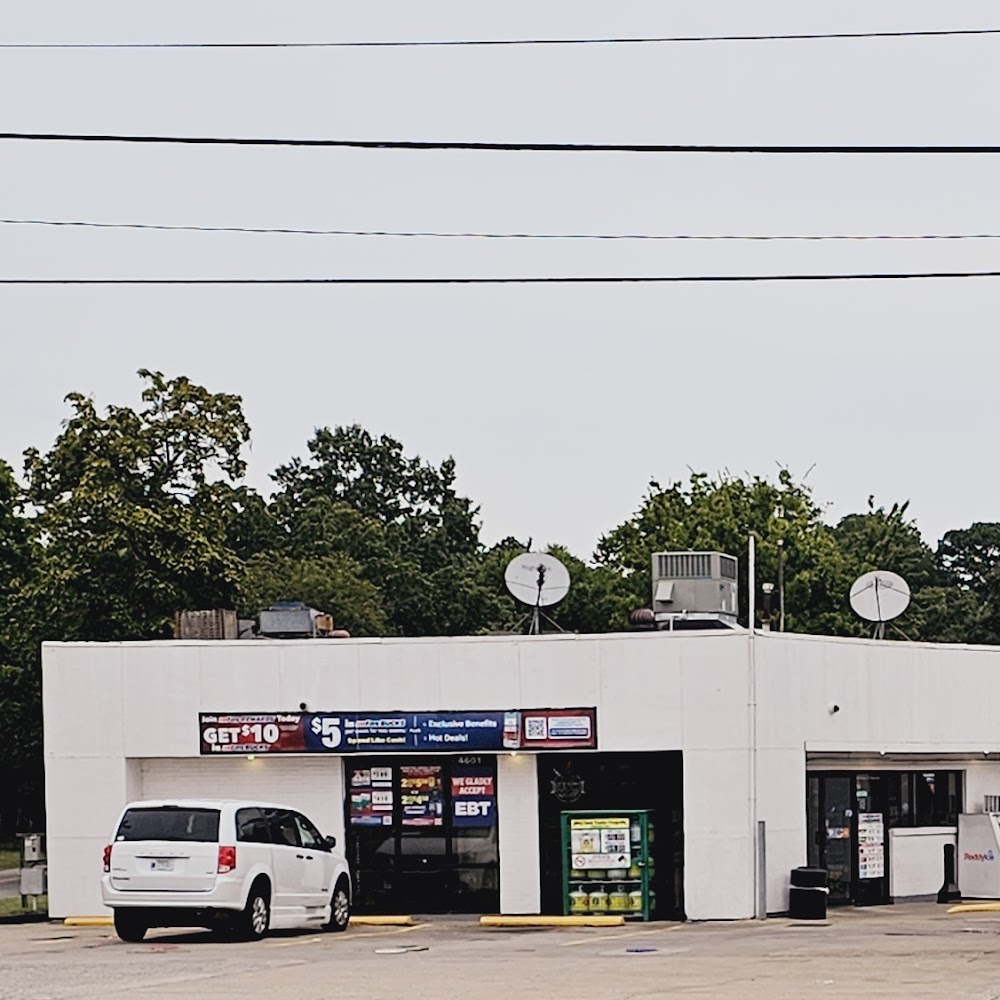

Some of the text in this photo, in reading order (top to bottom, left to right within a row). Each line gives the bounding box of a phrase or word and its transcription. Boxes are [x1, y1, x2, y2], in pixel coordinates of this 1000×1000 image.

[276, 715, 300, 723] Today
[428, 719, 497, 728] Exclusive Benefits
[203, 724, 279, 743] GET $10
[311, 717, 342, 748] $5
[429, 733, 468, 742] Hot Deals!
[452, 777, 493, 786] WE GLADLY
[459, 786, 486, 795] ACCEPT
[455, 801, 491, 816] EBT
